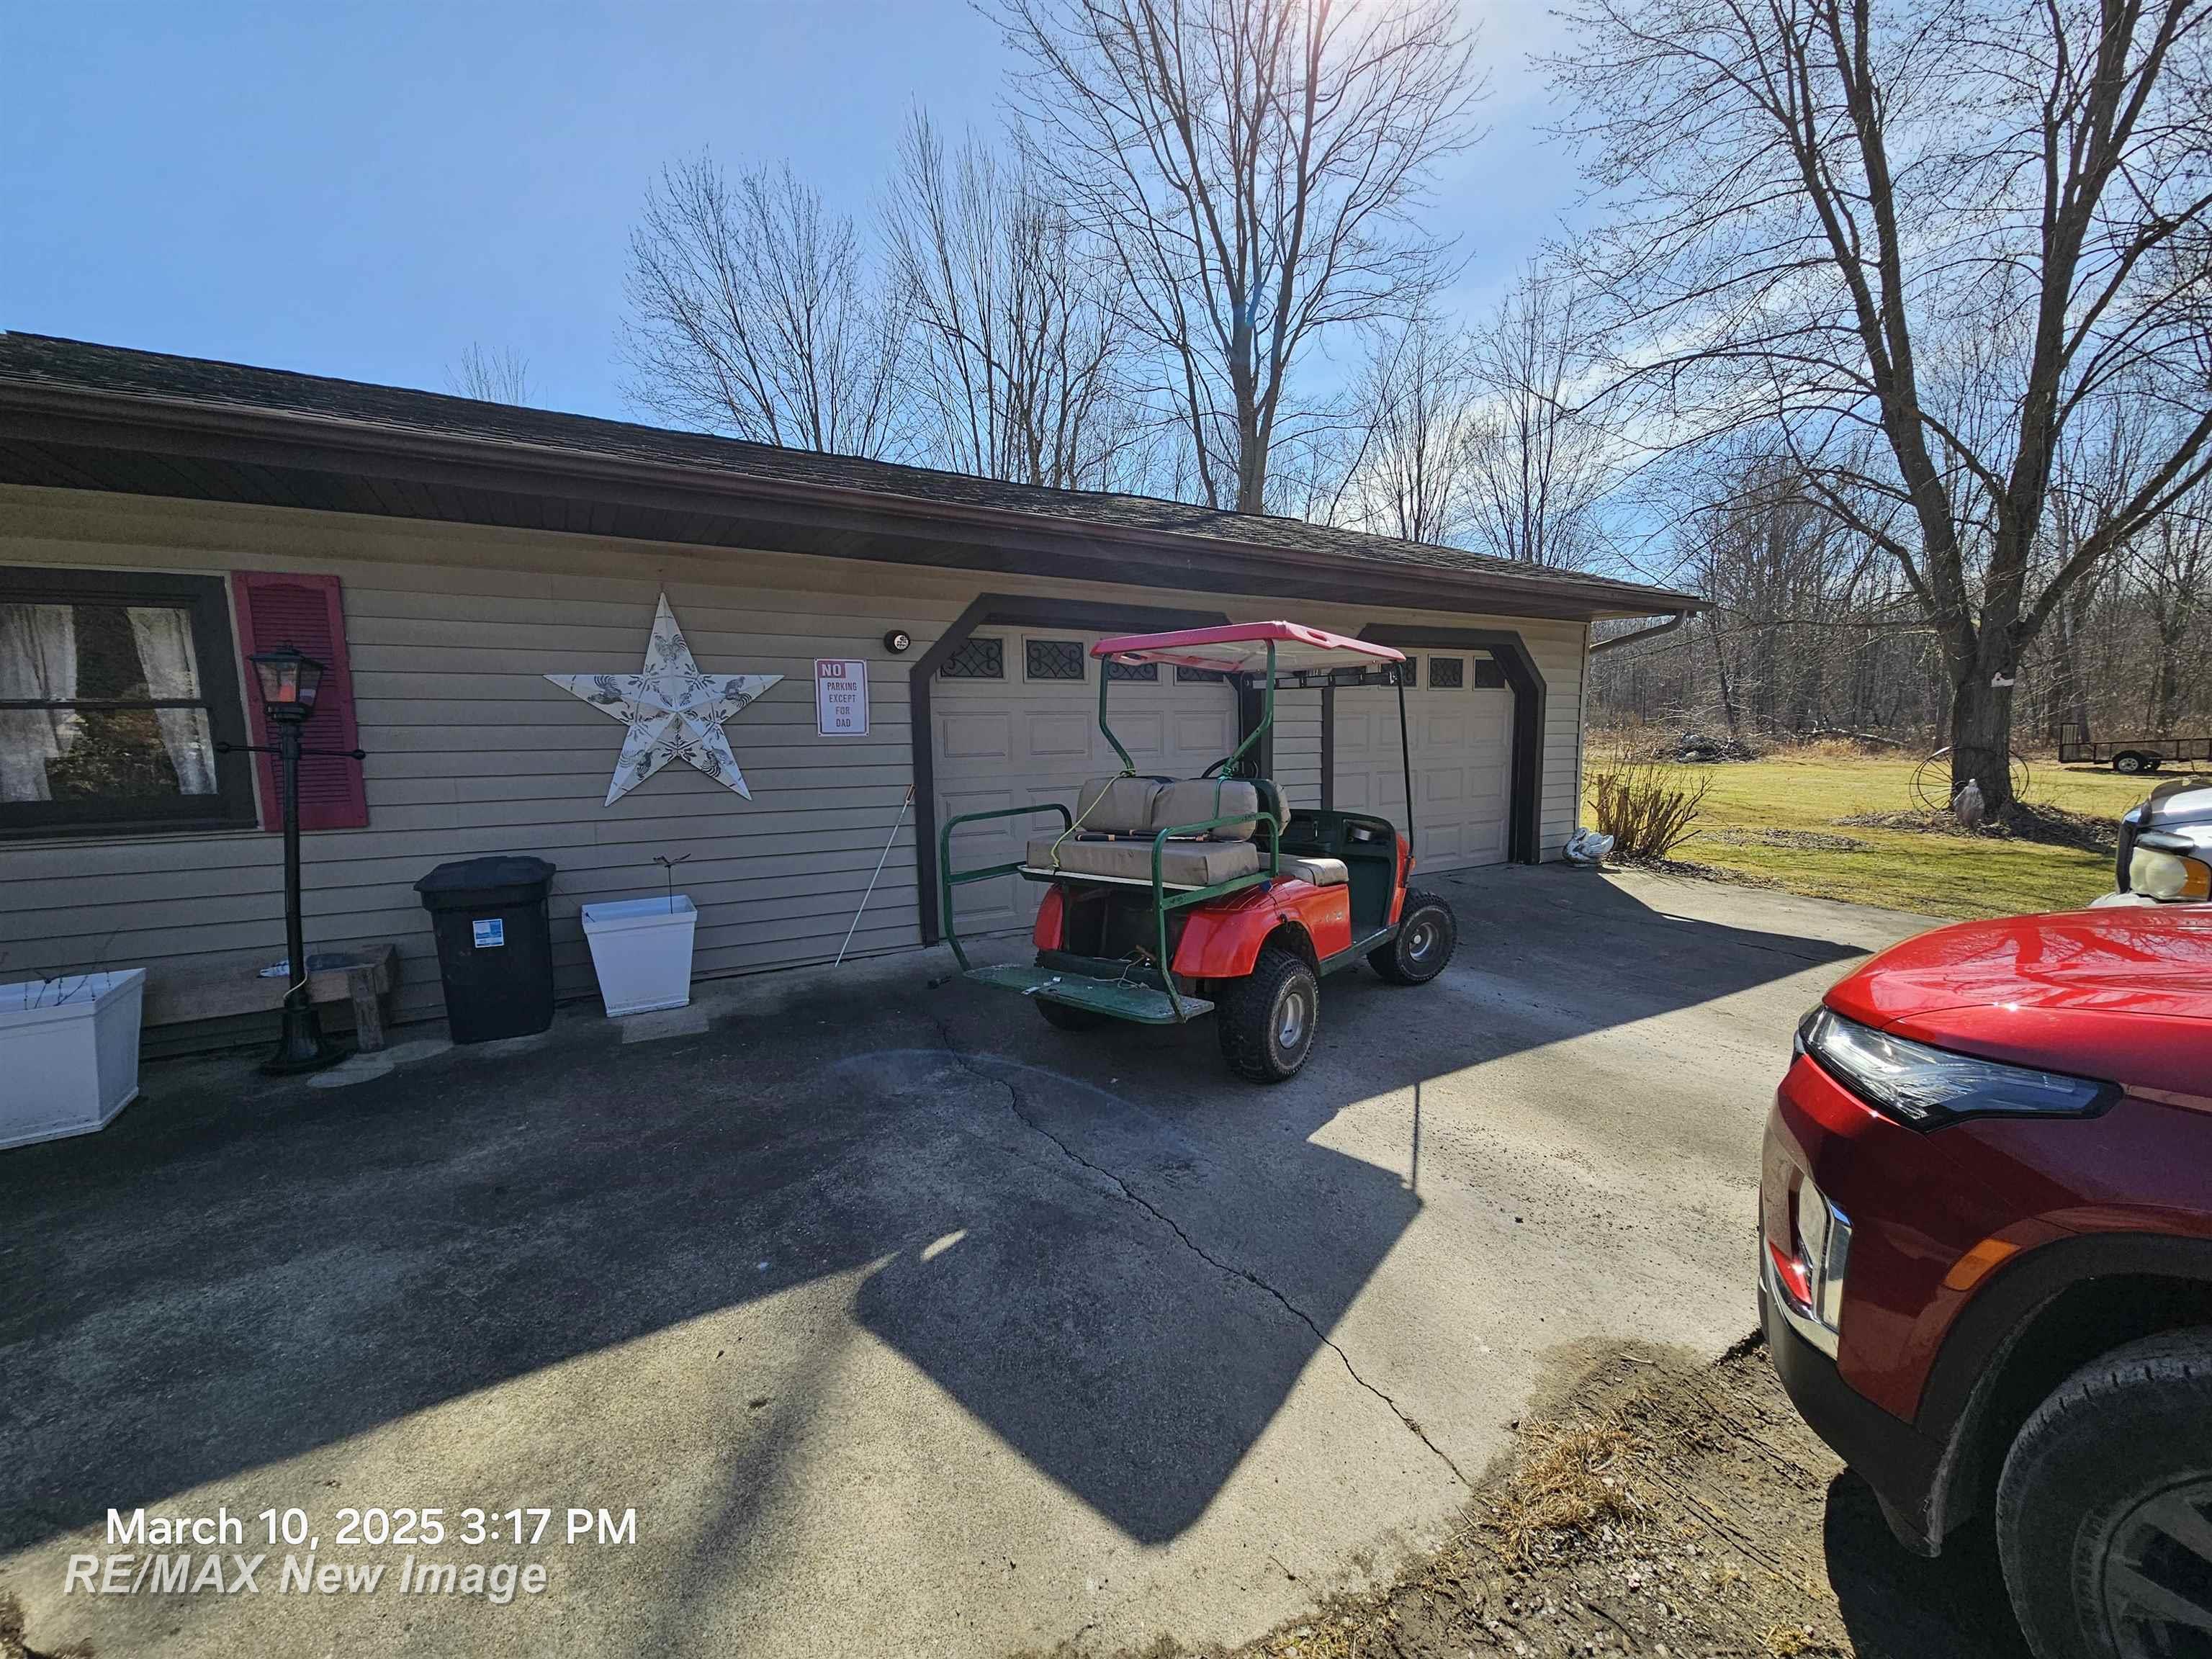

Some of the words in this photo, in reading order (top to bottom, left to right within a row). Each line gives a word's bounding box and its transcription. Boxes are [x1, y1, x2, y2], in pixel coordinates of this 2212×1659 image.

[822, 664, 842, 676] NO
[827, 682, 858, 691] PARKING
[829, 694, 856, 703] EXCEPT
[836, 719, 851, 727] DAD
